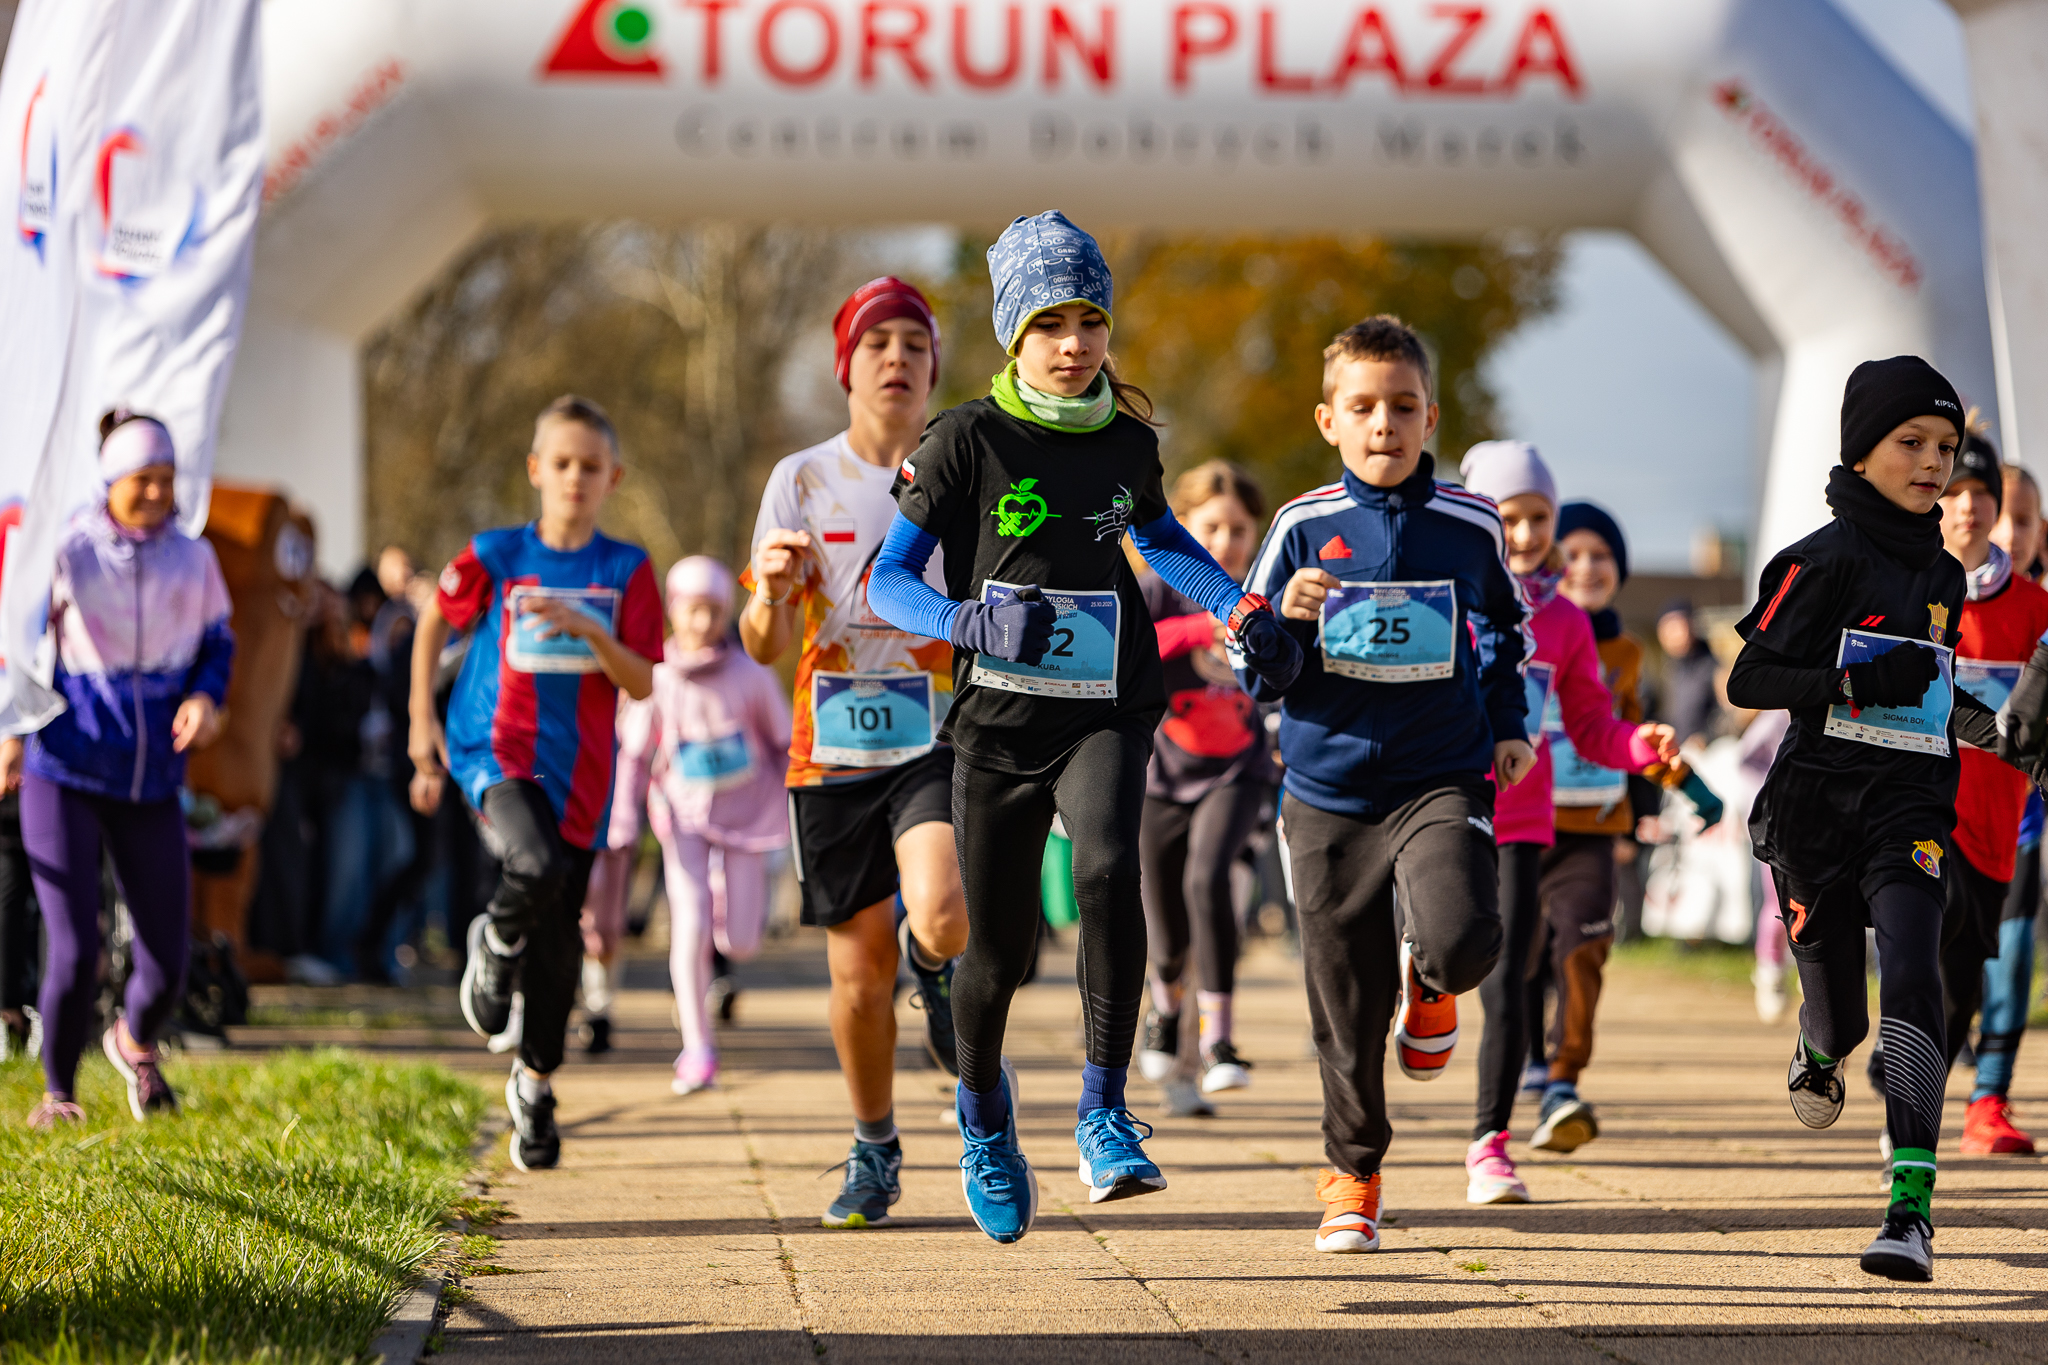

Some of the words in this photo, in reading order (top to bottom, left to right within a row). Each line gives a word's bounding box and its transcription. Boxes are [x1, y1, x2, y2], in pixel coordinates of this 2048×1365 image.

[1168, 0, 1586, 97] PLAZA
[674, 104, 990, 162] Centrum
[1028, 106, 1336, 174] Dobrych
[1934, 399, 1958, 412] KIPSTA
[1045, 595, 1074, 604] YLOGIA
[1369, 617, 1411, 645] 25
[1037, 663, 1061, 672] KUBA
[846, 705, 892, 731] 101
[1882, 713, 1908, 723] SIGMA
[1910, 717, 1926, 725] BOY
[1789, 898, 1807, 943] 7
